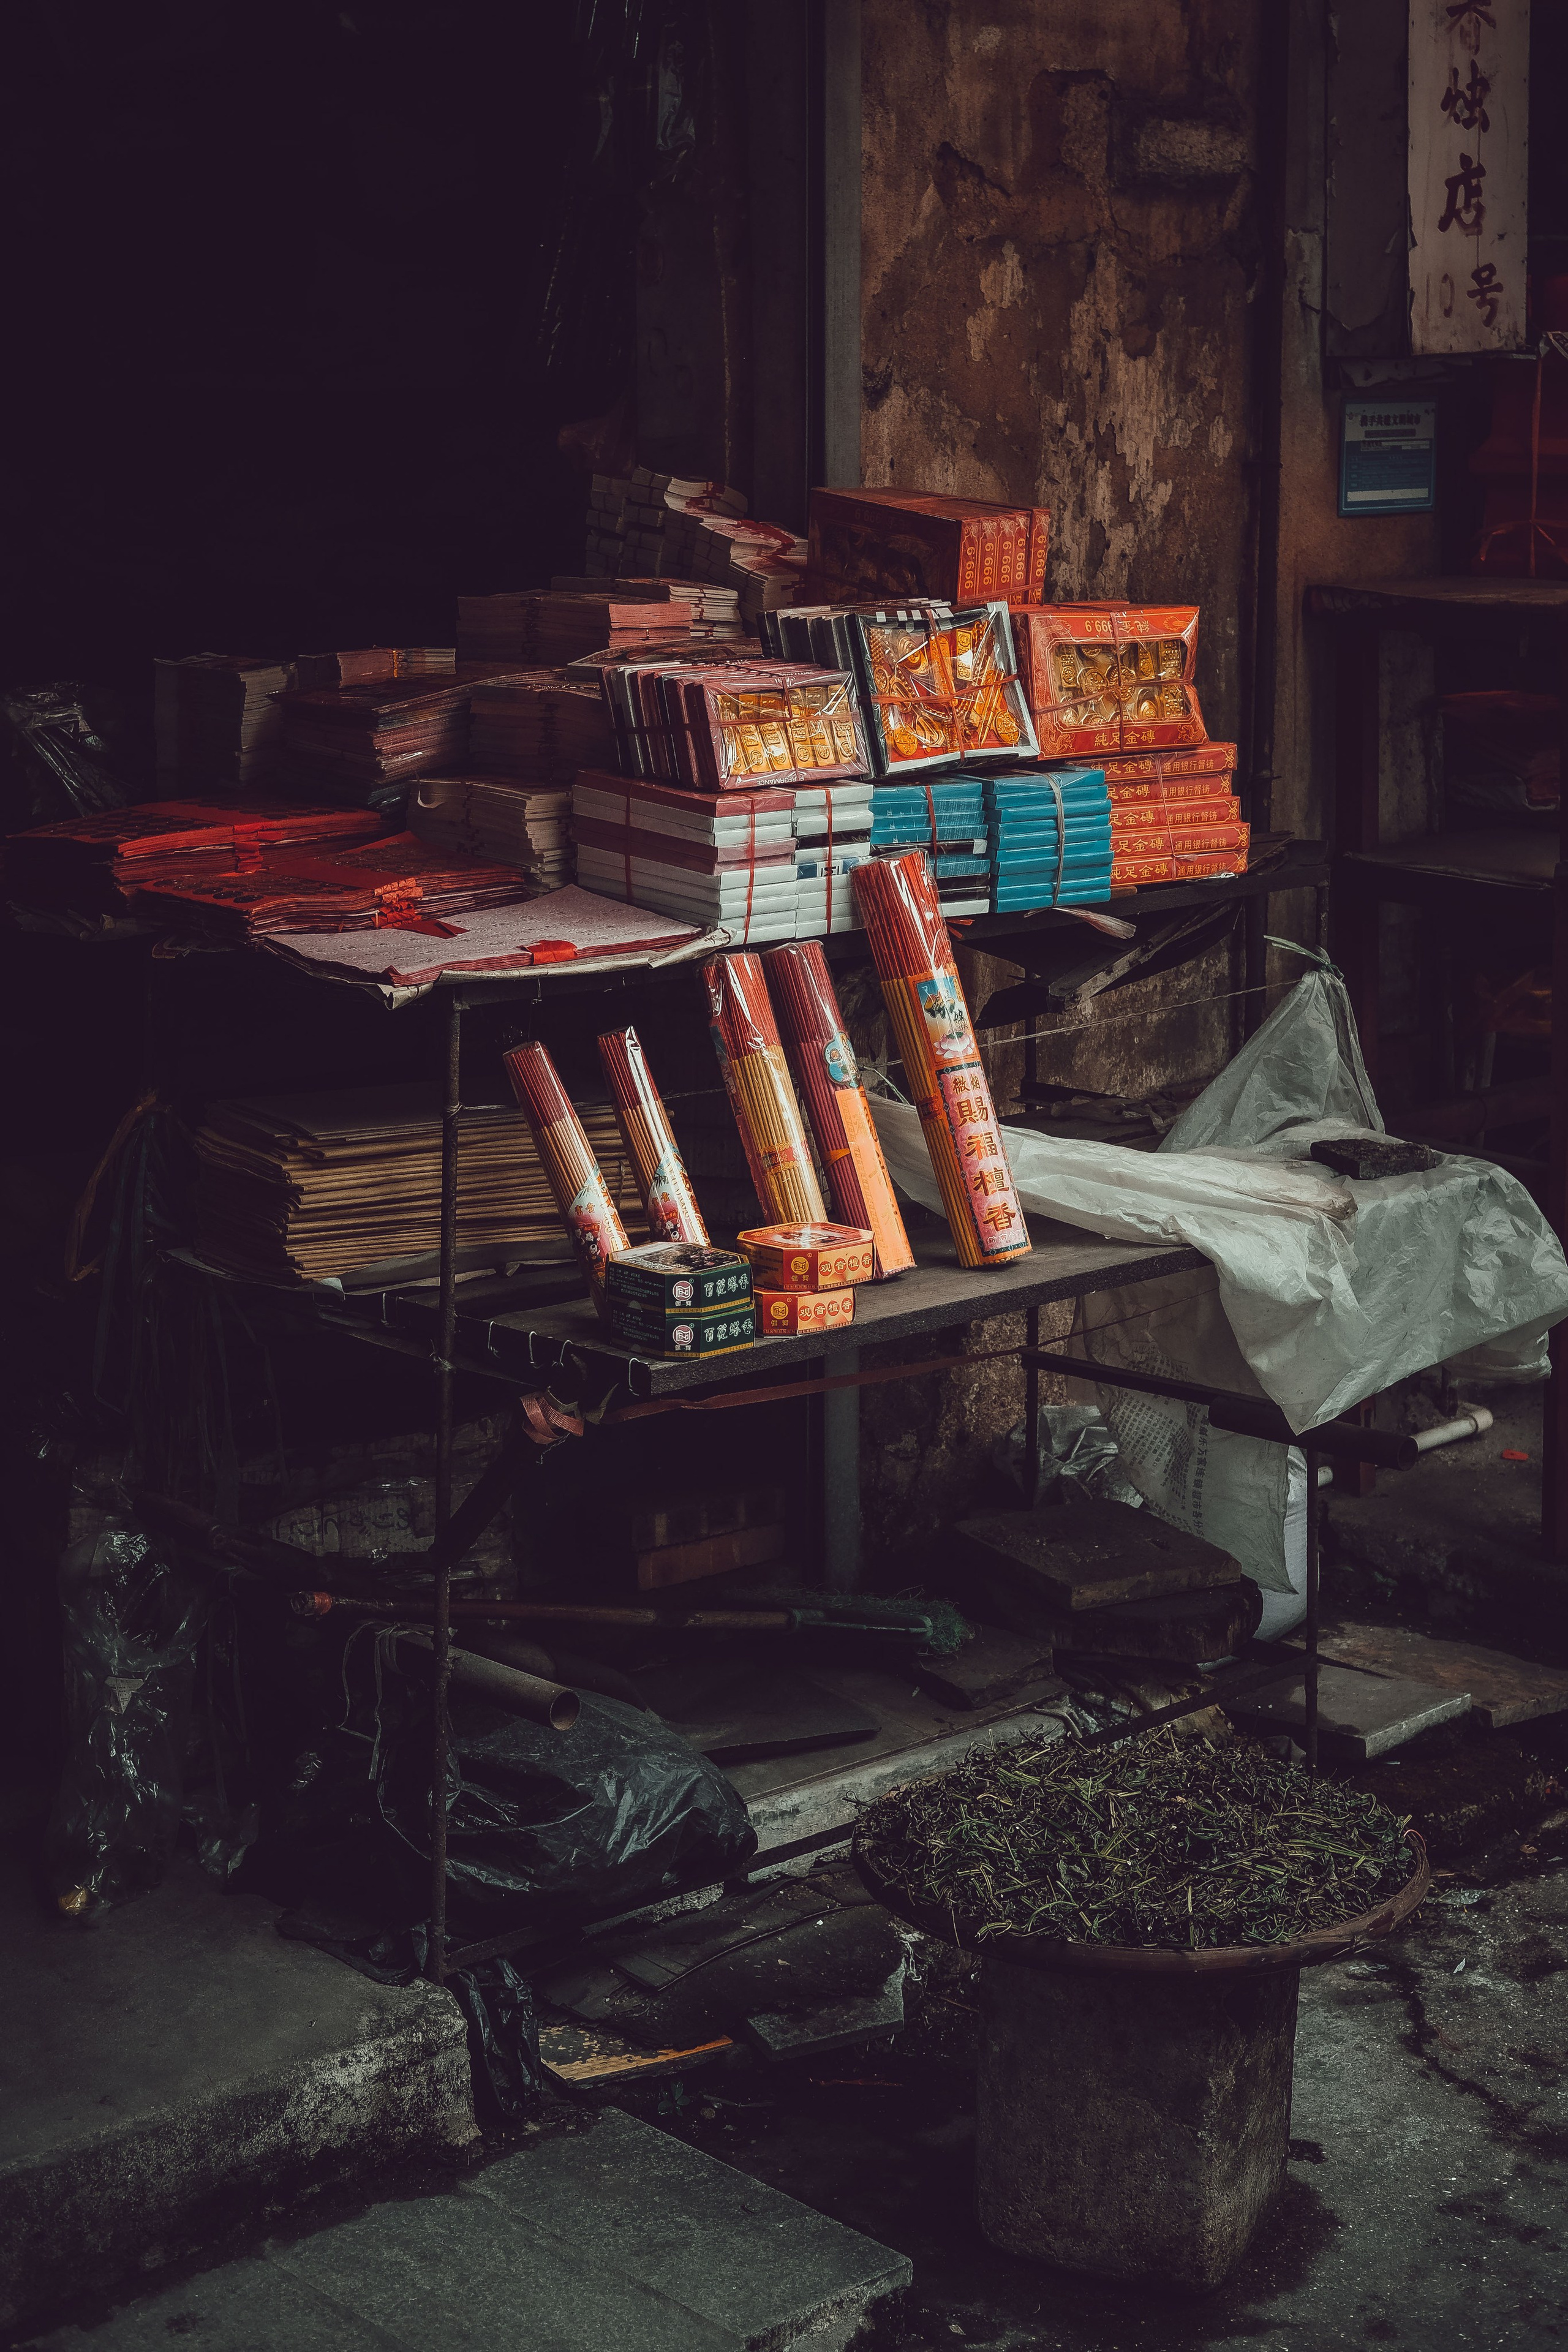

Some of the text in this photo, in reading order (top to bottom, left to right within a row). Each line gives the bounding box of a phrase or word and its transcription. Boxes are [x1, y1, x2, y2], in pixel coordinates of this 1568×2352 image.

[756, 775, 804, 786] PRFORMANCE
[1110, 837, 1165, 853] 足金磚
[957, 1096, 1016, 1232] 賜福檀香
[820, 1253, 872, 1274] 观音檀香
[704, 1273, 749, 1297] 百花塔香
[799, 1298, 852, 1318] 观音檀香
[704, 1318, 753, 1342] 百花塔香
